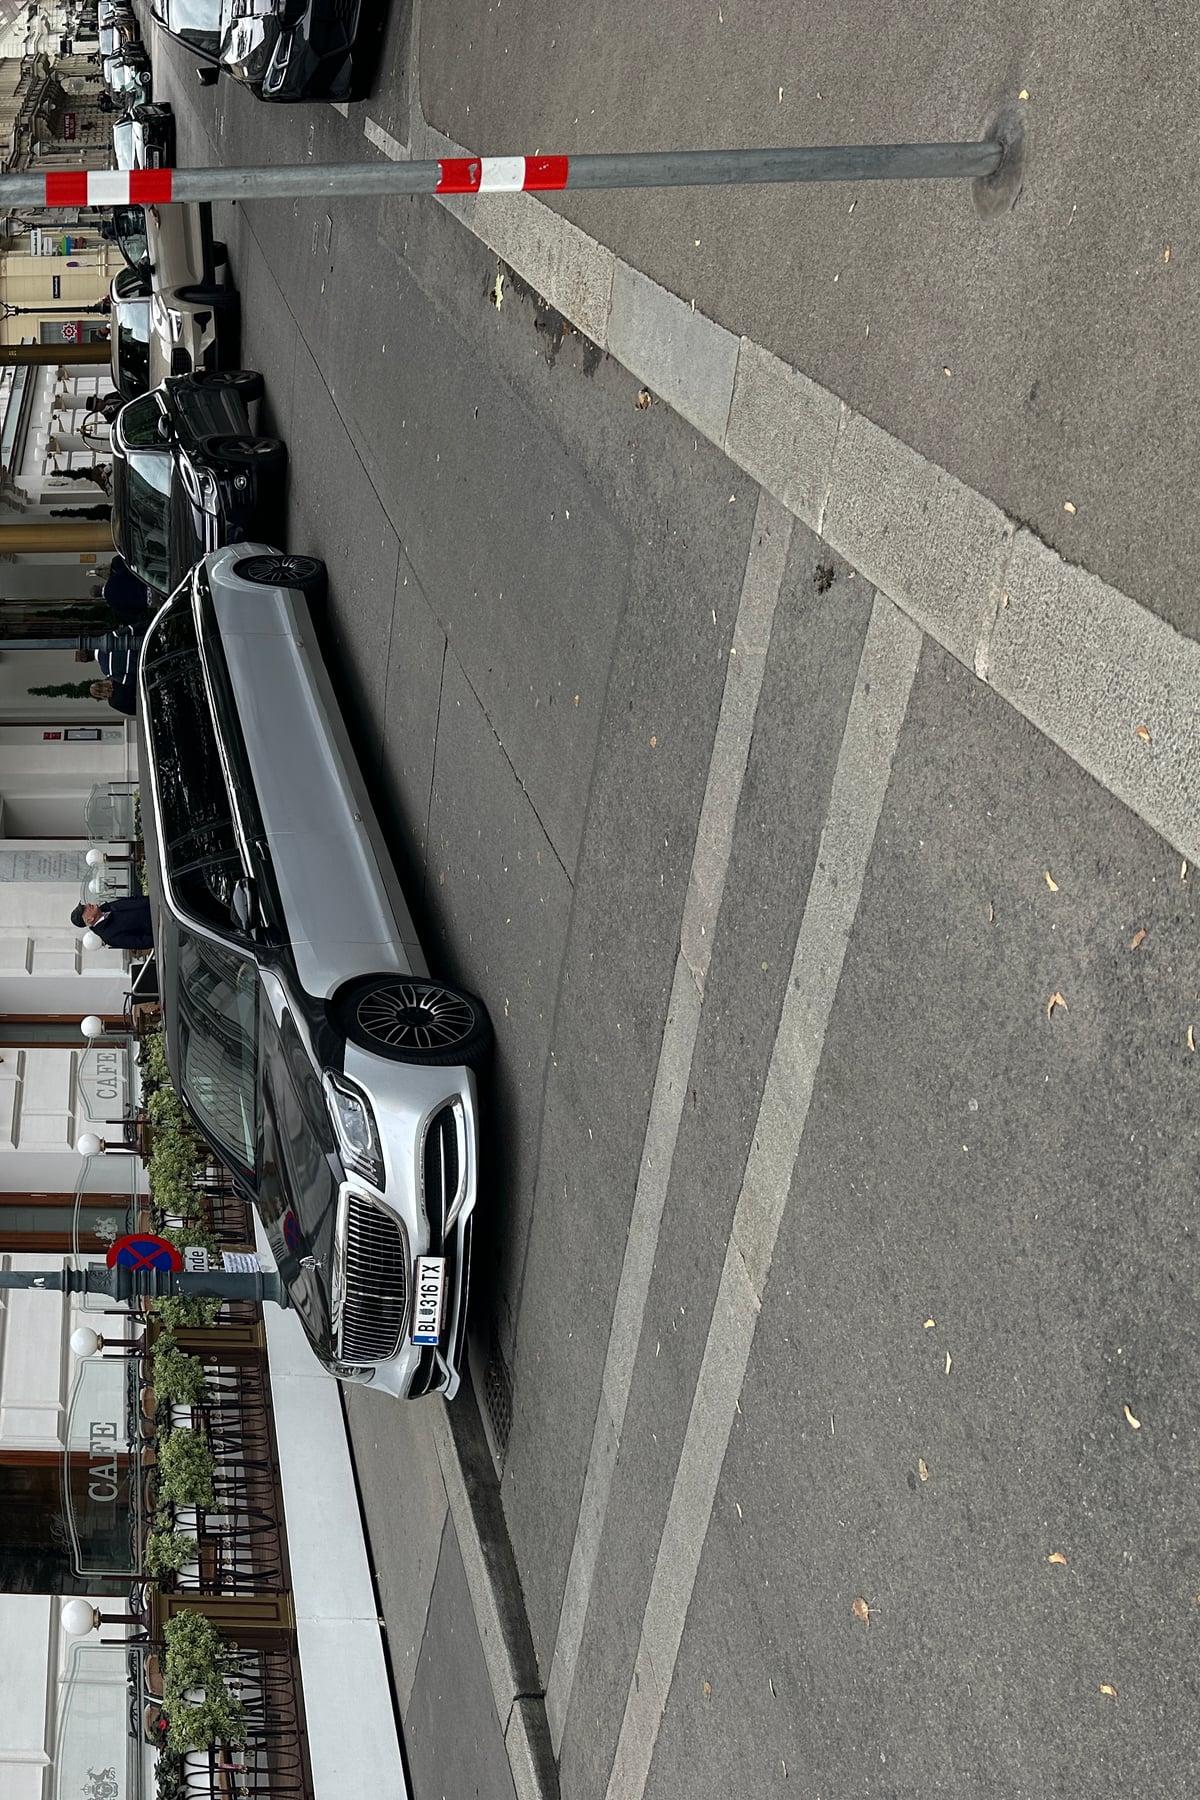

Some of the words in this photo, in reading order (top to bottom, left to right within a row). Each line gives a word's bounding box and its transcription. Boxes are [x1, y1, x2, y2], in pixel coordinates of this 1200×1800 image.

[96, 1053, 118, 1100] CAFE
[188, 1250, 204, 1271] nde
[422, 1265, 440, 1281] TX
[420, 1285, 438, 1307] 316
[418, 1318, 435, 1332] BL
[88, 1422, 118, 1502] CAFE
